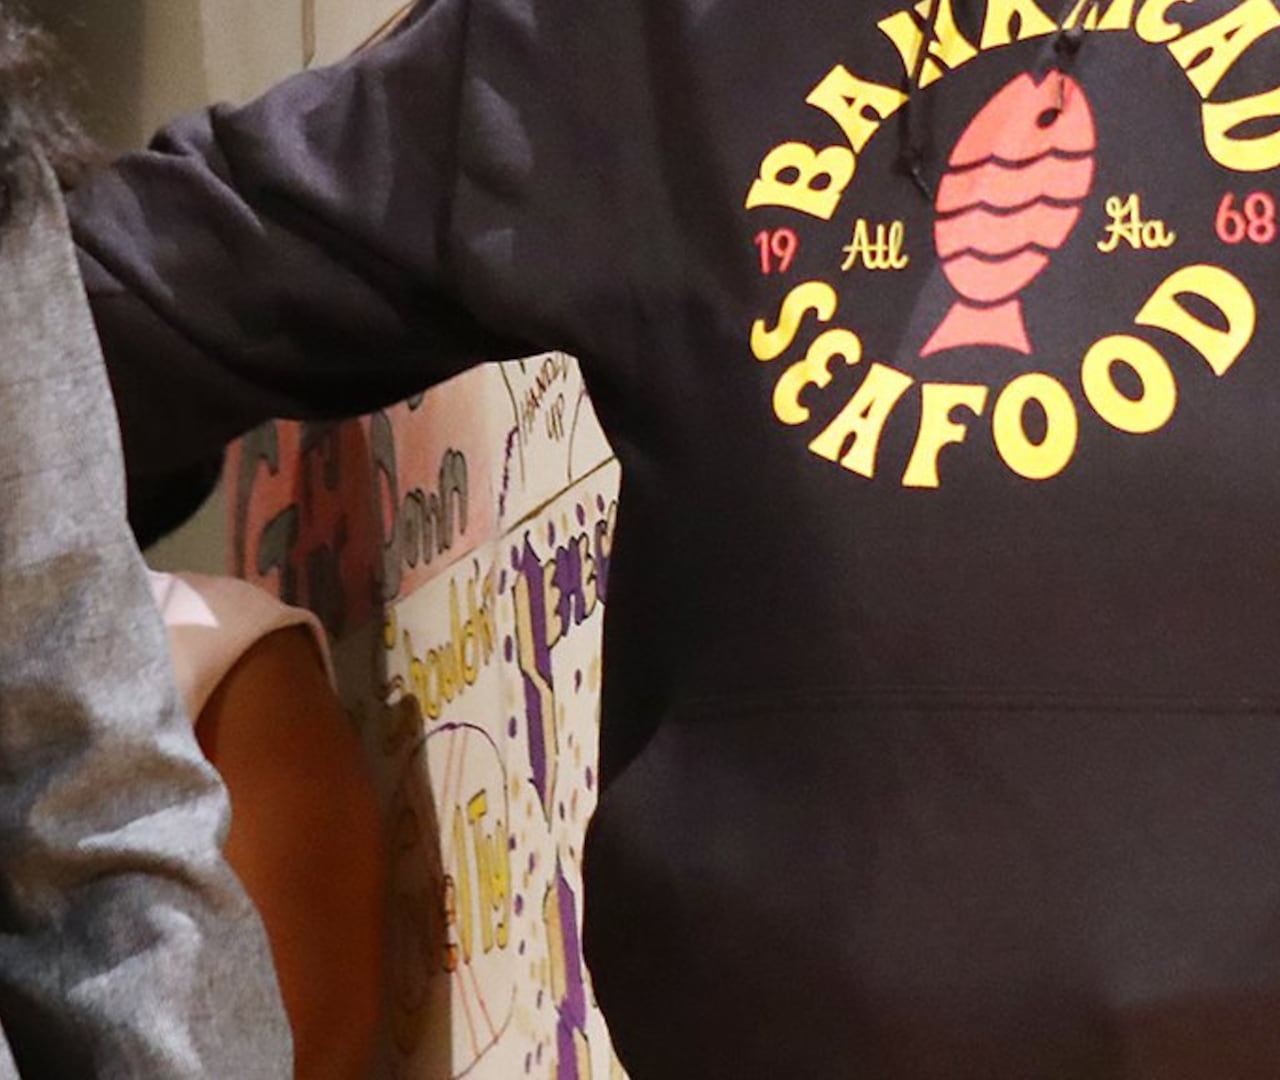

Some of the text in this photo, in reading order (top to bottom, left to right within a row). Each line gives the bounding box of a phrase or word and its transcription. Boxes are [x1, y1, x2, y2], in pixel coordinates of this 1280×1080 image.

[753, 228, 799, 275] 19
[841, 220, 909, 271] Atl
[1214, 191, 1278, 245] 68
[749, 264, 1257, 488] SEAFOOD
